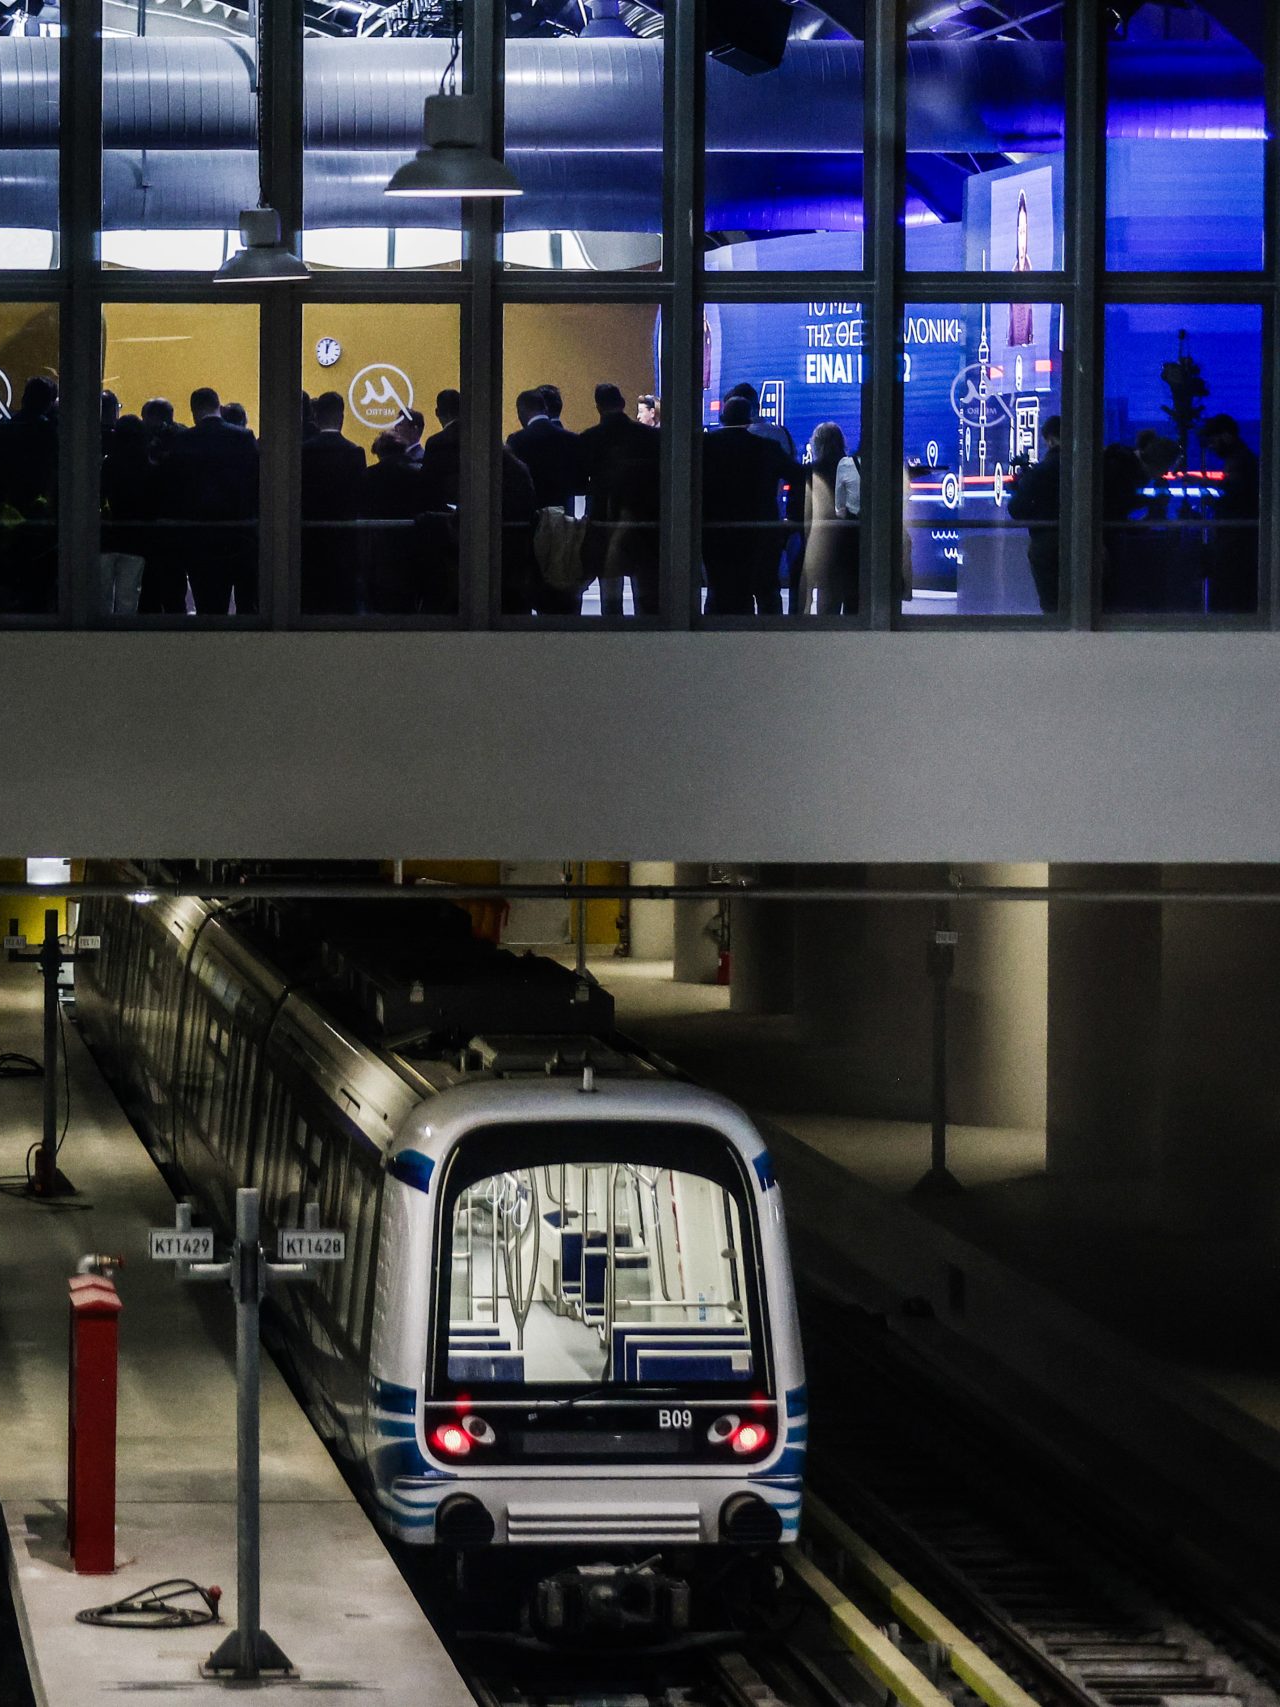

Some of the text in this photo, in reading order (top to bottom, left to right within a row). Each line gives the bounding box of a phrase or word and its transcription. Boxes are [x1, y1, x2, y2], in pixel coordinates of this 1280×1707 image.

[805, 324, 833, 347] ΤΗΣ
[805, 353, 853, 384] ΕΙΝΑΙ
[155, 1238, 210, 1254] KT1429
[286, 1238, 341, 1254] KT1428
[659, 1409, 692, 1428] B09
